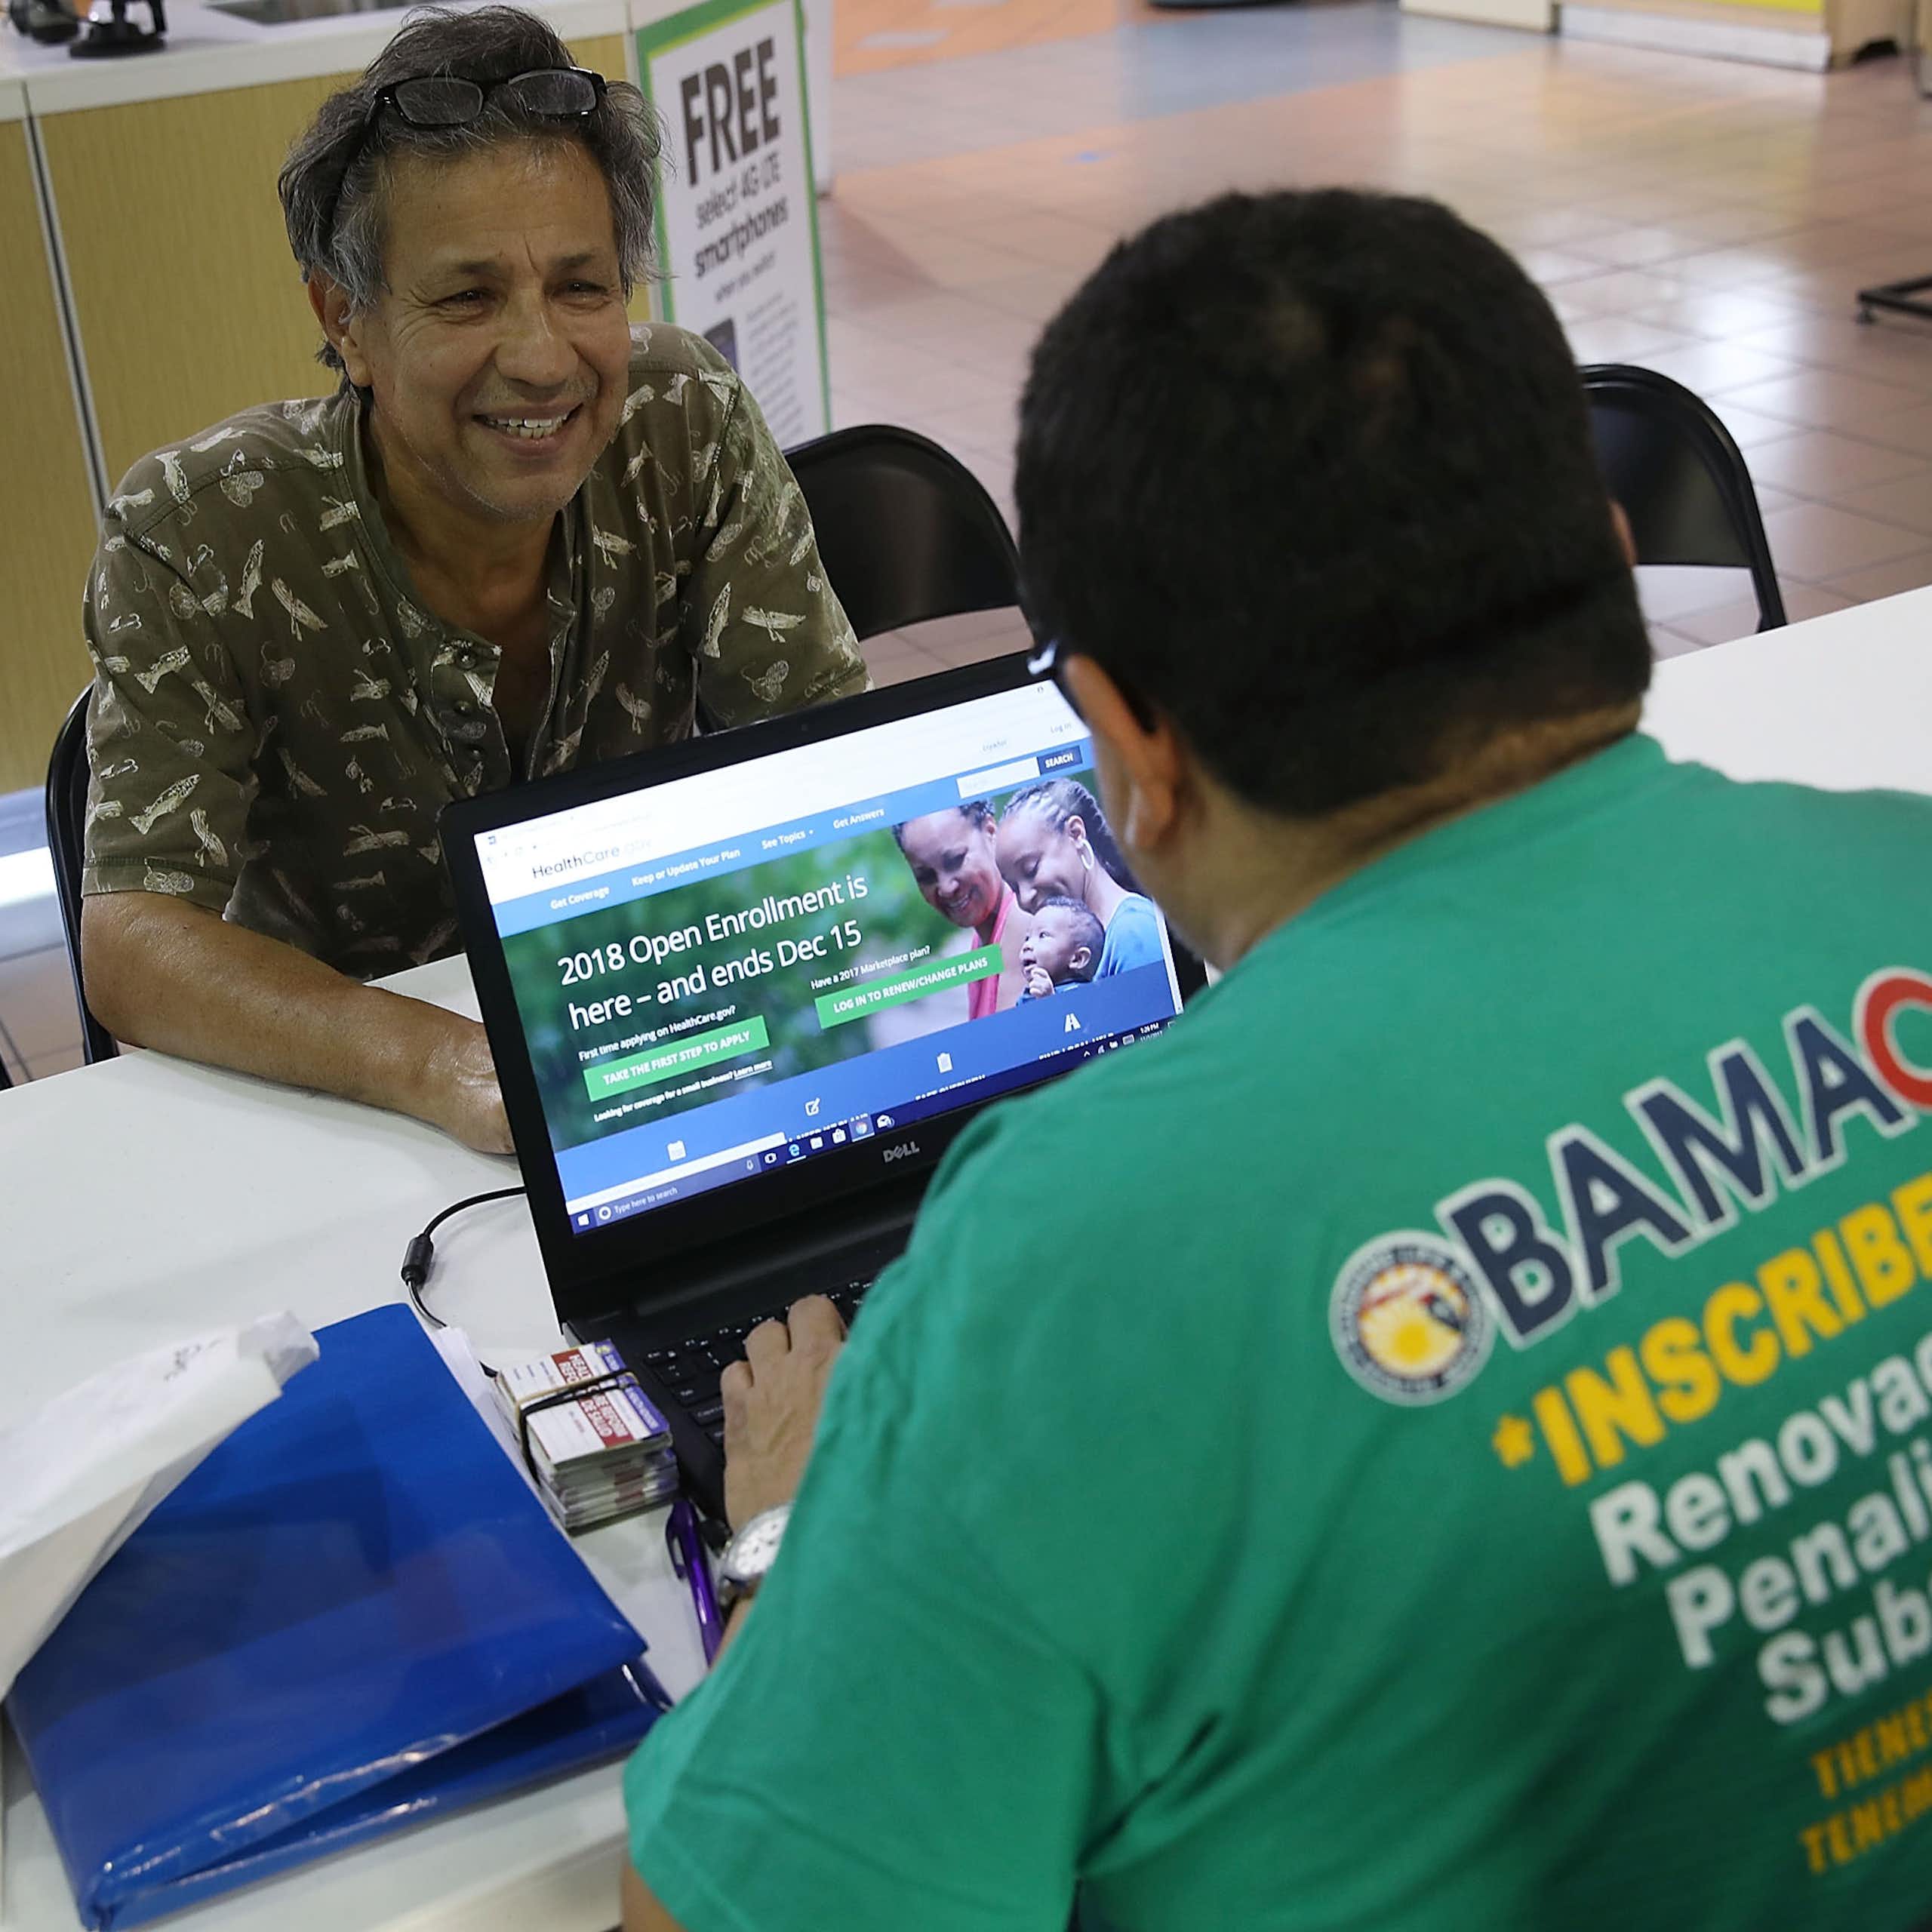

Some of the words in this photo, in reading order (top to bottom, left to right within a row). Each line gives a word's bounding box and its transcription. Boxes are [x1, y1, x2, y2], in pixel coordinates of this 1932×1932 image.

[681, 35, 780, 188] FREE
[695, 195, 789, 279] smartphones
[1044, 752, 1074, 769] SEARCH
[761, 838, 778, 851] See
[778, 830, 806, 847] Topics
[833, 818, 849, 829] Get
[850, 808, 885, 826] Answers
[532, 837, 652, 878] HealthCaregov
[631, 873, 655, 888] Keep
[655, 870, 666, 880] or
[666, 861, 699, 878] Update
[699, 854, 720, 869] Your
[721, 849, 740, 863] Plan
[550, 897, 568, 910] Get
[568, 886, 611, 906] Coverage
[557, 943, 626, 986] 2018
[629, 925, 703, 965] Open
[705, 881, 845, 942] Enrollment
[846, 875, 869, 900] is
[568, 993, 632, 1030] here
[657, 964, 707, 1004] and
[711, 948, 774, 987] ends
[777, 934, 828, 968] Dec
[829, 919, 863, 950] 15
[810, 977, 832, 990] Have
[838, 966, 860, 981] 2017
[860, 955, 909, 975] Marketplace
[909, 945, 931, 961] plan?
[833, 998, 854, 1014] LOG
[855, 995, 867, 1008] IN
[867, 991, 882, 1003] TO
[882, 969, 957, 998] RENEW/CHANGE
[958, 957, 989, 976] PLANS
[578, 1050, 598, 1062] First
[598, 1041, 620, 1057] time
[620, 1030, 657, 1050] applying
[657, 1027, 669, 1038] on
[669, 1004, 737, 1034] HealthCare.gov?
[602, 1070, 629, 1086] TAKE
[631, 1060, 651, 1078] THE
[651, 1054, 678, 1071] FIRST
[679, 1046, 703, 1063] STEP
[703, 1041, 718, 1056] TO
[719, 1030, 751, 1050] APPLY
[593, 1107, 623, 1122] Looking
[623, 1103, 634, 1114] for
[633, 1094, 666, 1110] coverage
[665, 1090, 675, 1101] for
[682, 1080, 701, 1094] small
[701, 1071, 734, 1089] business?
[734, 1066, 753, 1078] Learn
[753, 1060, 773, 1072] more
[882, 1141, 920, 1163] DELL
[614, 1203, 630, 1214] Type
[631, 1197, 647, 1208] here
[647, 1195, 656, 1204] to
[656, 1186, 678, 1200] search
[1756, 1570, 1932, 1724] Sub
[1811, 1687, 1932, 1799] TIENE
